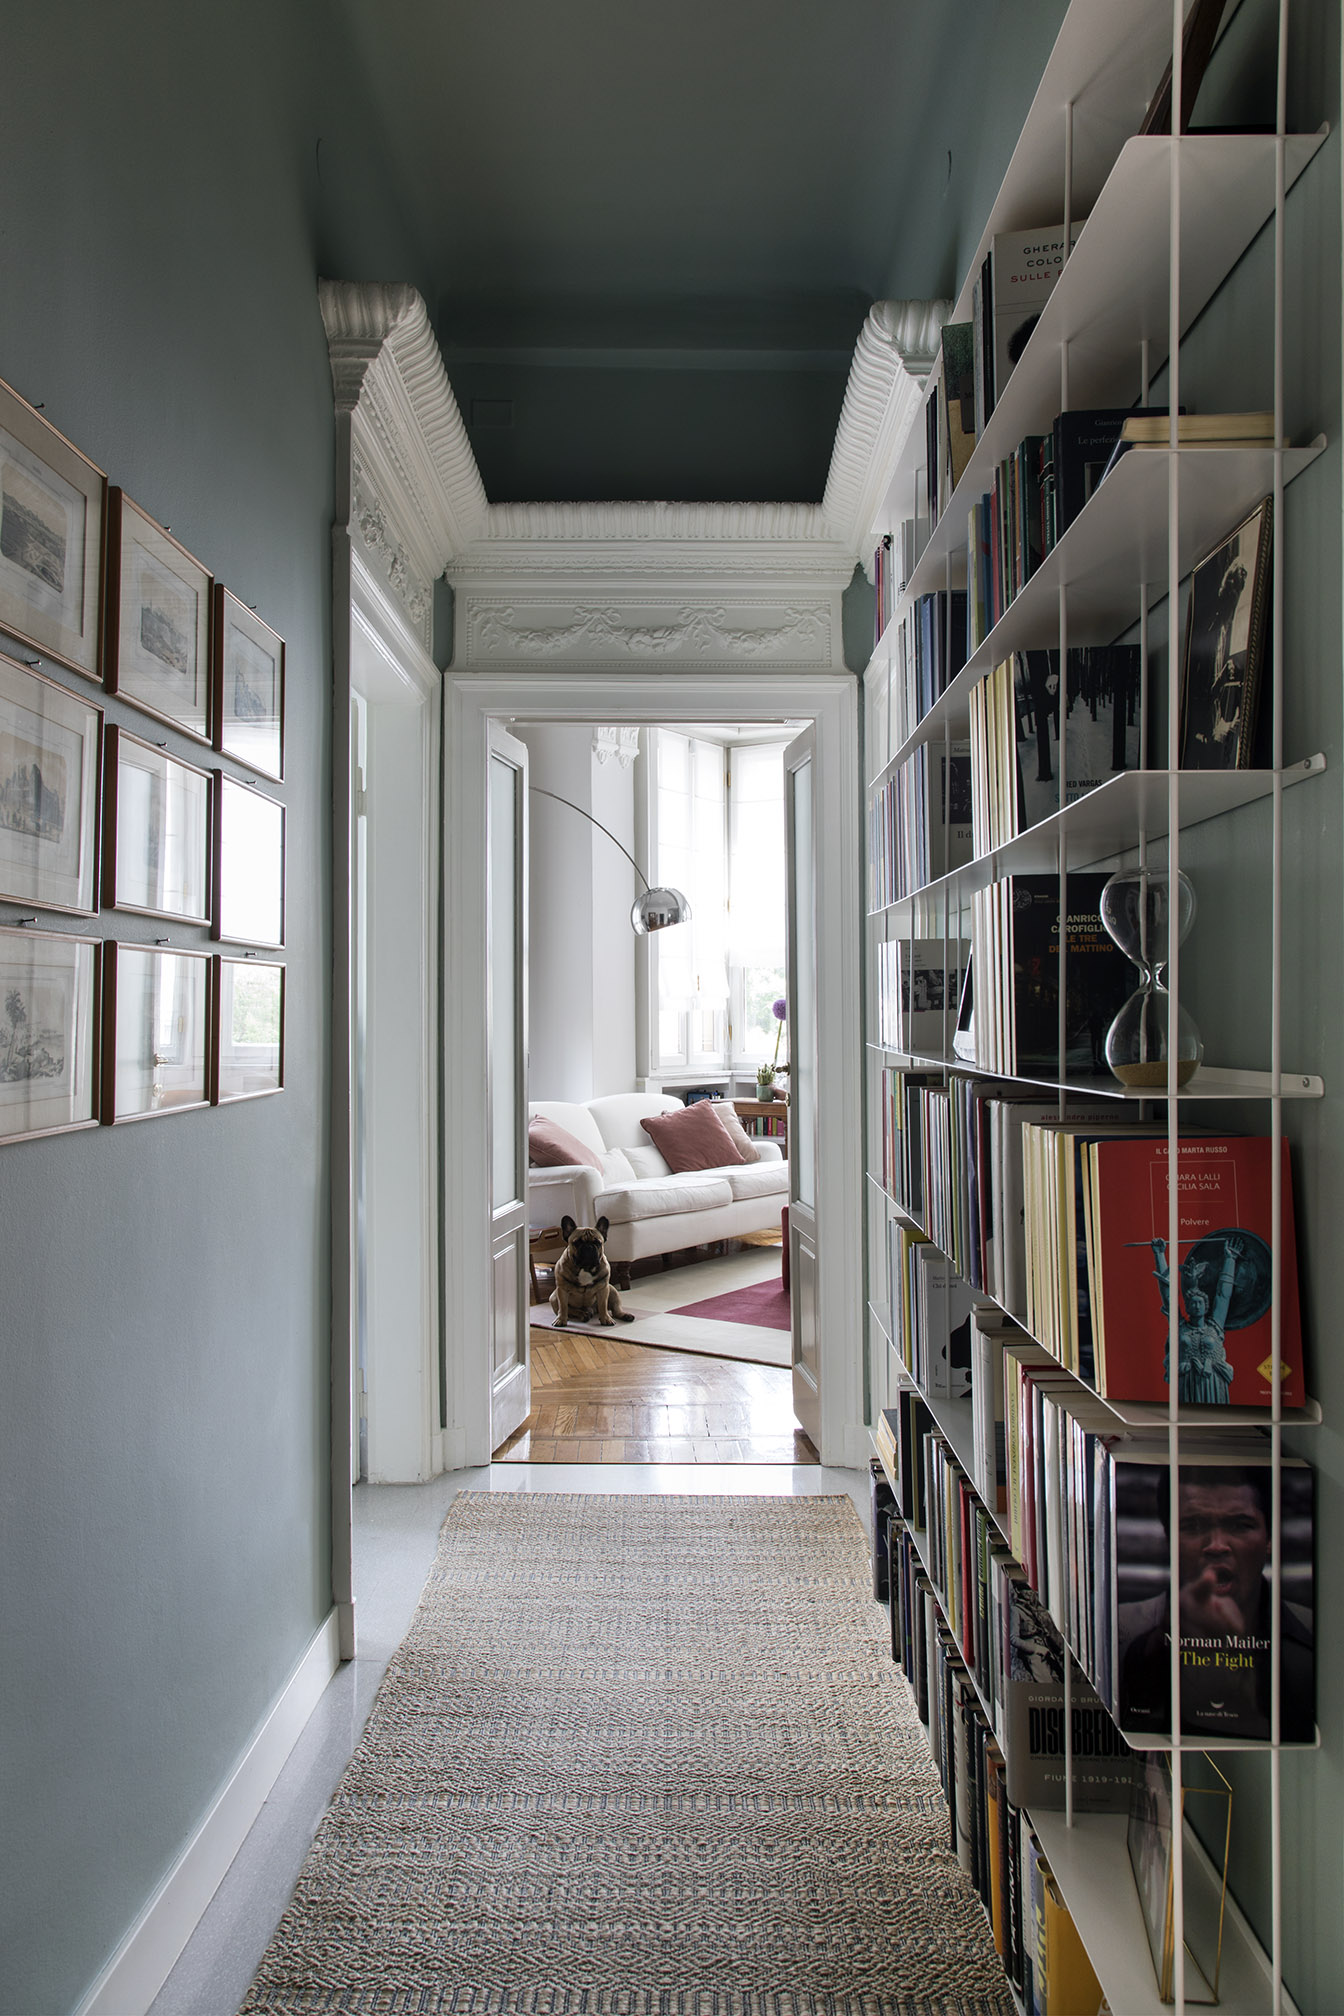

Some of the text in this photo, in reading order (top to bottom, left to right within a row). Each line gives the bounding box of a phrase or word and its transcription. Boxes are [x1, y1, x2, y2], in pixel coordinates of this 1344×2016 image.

[1010, 271, 1051, 283] SULLE
[1078, 779, 1103, 788] VARGAS
[1079, 934, 1097, 943] TRE
[1070, 944, 1114, 953] MATTINO
[1181, 1146, 1204, 1154] MARTA
[1205, 1146, 1228, 1154] RUSSO
[1198, 1173, 1221, 1181] LALLI
[1199, 1182, 1221, 1190] SALA
[1180, 1218, 1210, 1226] Polvere
[1225, 1633, 1271, 1650] Mailer
[1180, 1650, 1255, 1671] The Fight
[1028, 1695, 1077, 1703] GIORDAO
